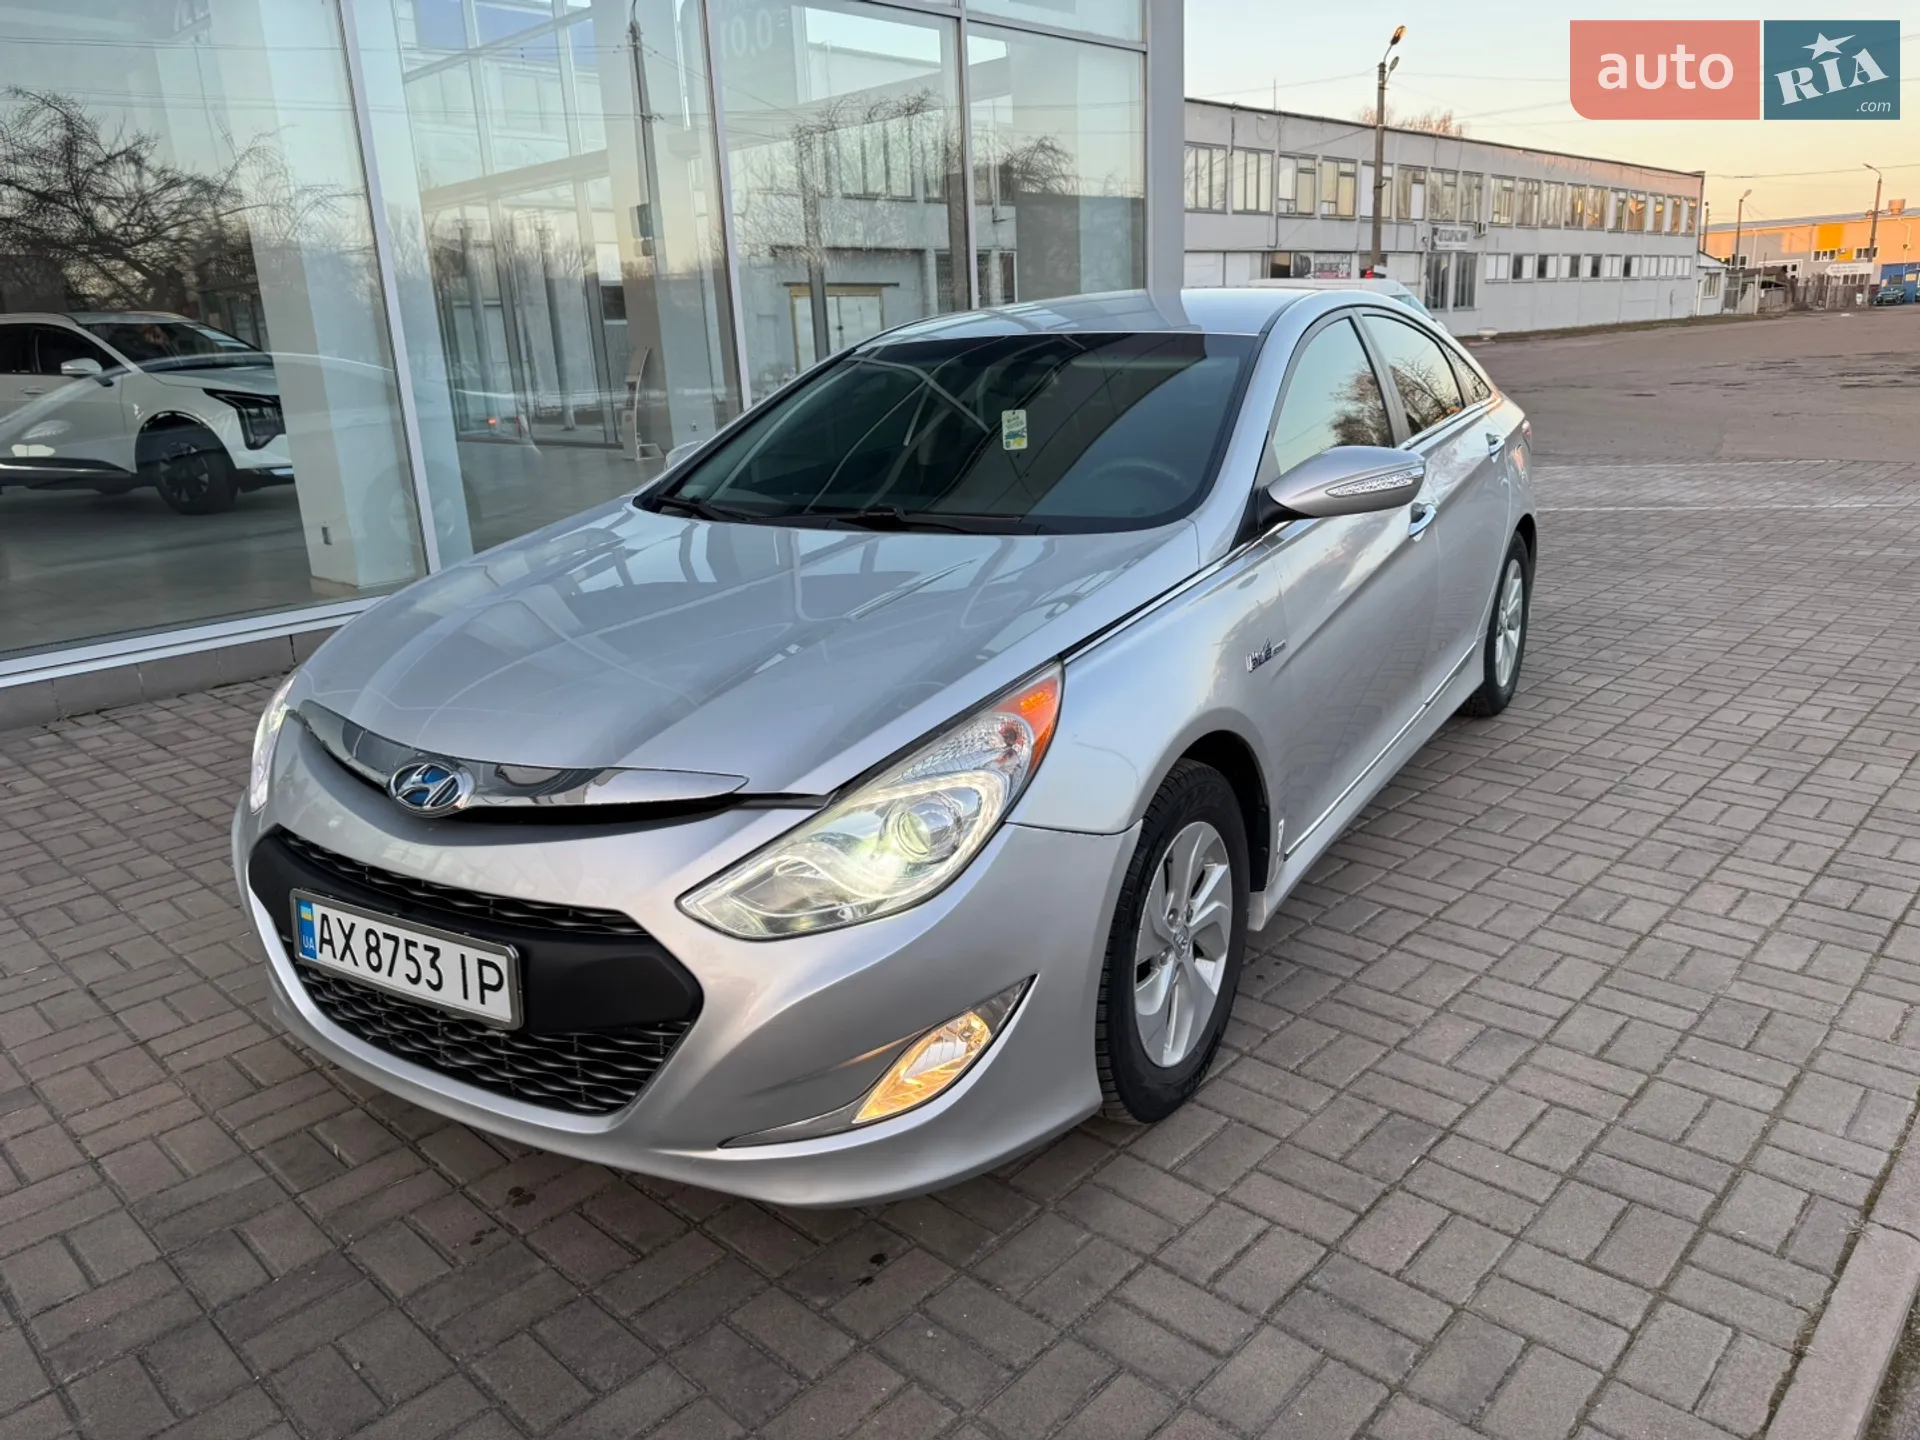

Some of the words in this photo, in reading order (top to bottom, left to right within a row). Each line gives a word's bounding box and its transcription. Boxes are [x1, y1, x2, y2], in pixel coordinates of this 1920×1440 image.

[301, 934, 316, 951] UA
[318, 913, 359, 967] AX
[365, 928, 443, 991] 8753
[460, 953, 505, 1005] IP
